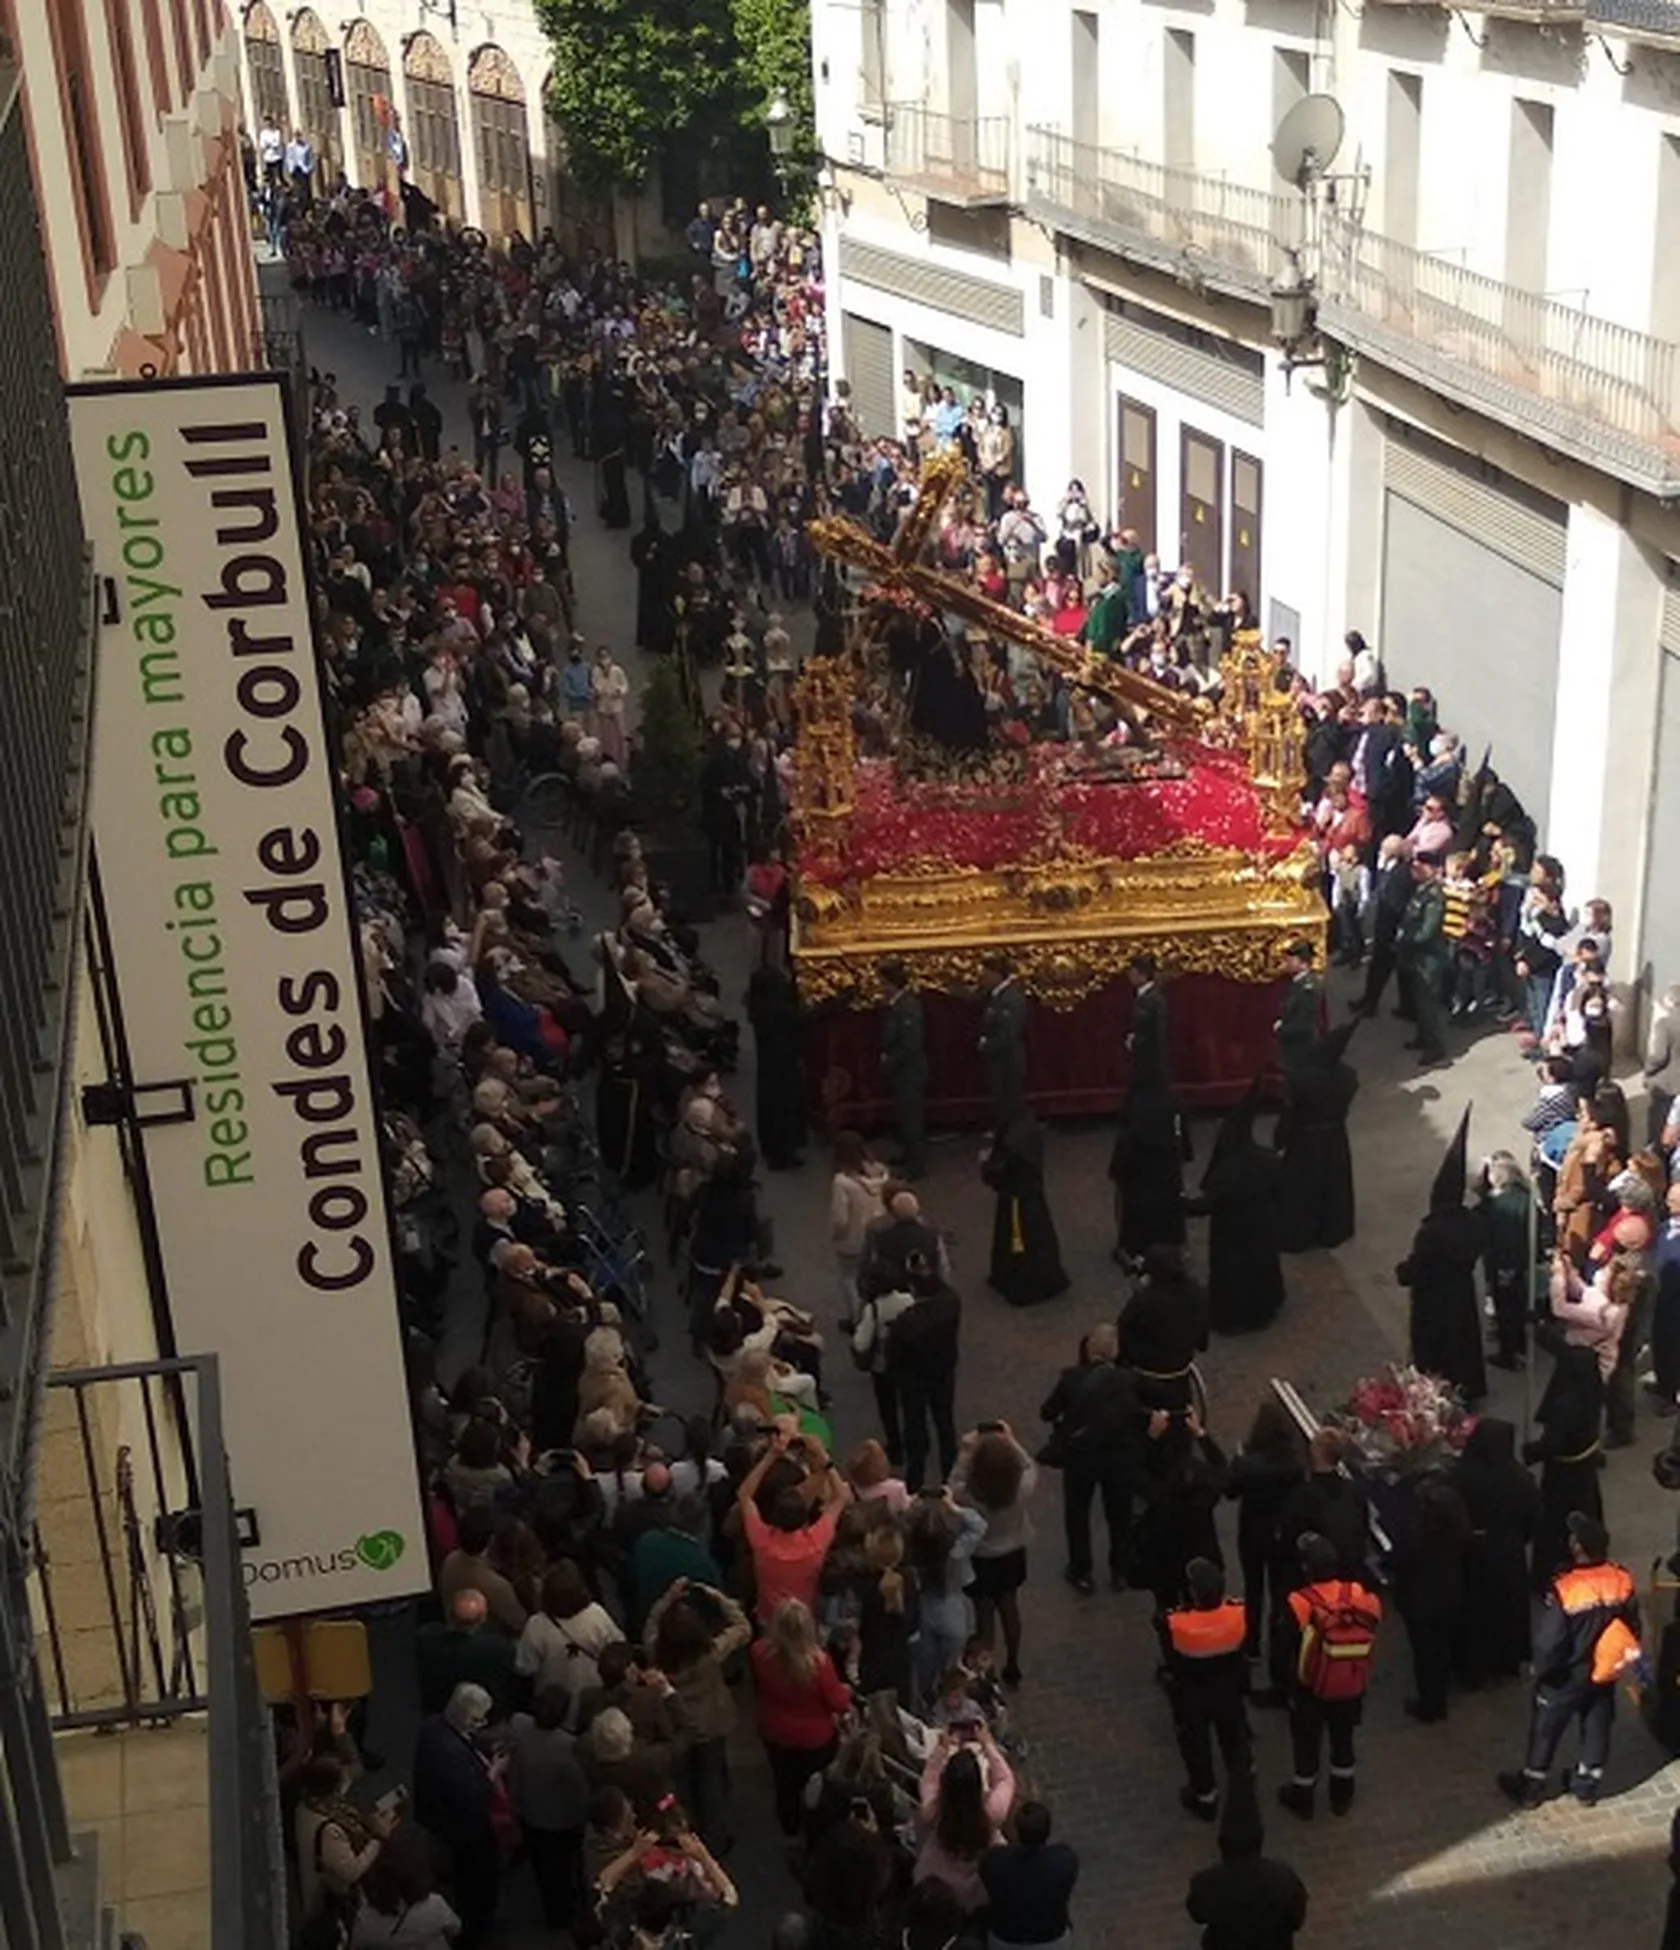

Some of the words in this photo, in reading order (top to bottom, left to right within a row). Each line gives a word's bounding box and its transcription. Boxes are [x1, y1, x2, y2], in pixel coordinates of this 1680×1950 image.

[108, 429, 184, 703] mayores
[179, 422, 309, 788] Corbull
[153, 726, 218, 859] para
[242, 826, 330, 933] de
[165, 879, 255, 1189] Residencia
[271, 969, 375, 1291] Condes
